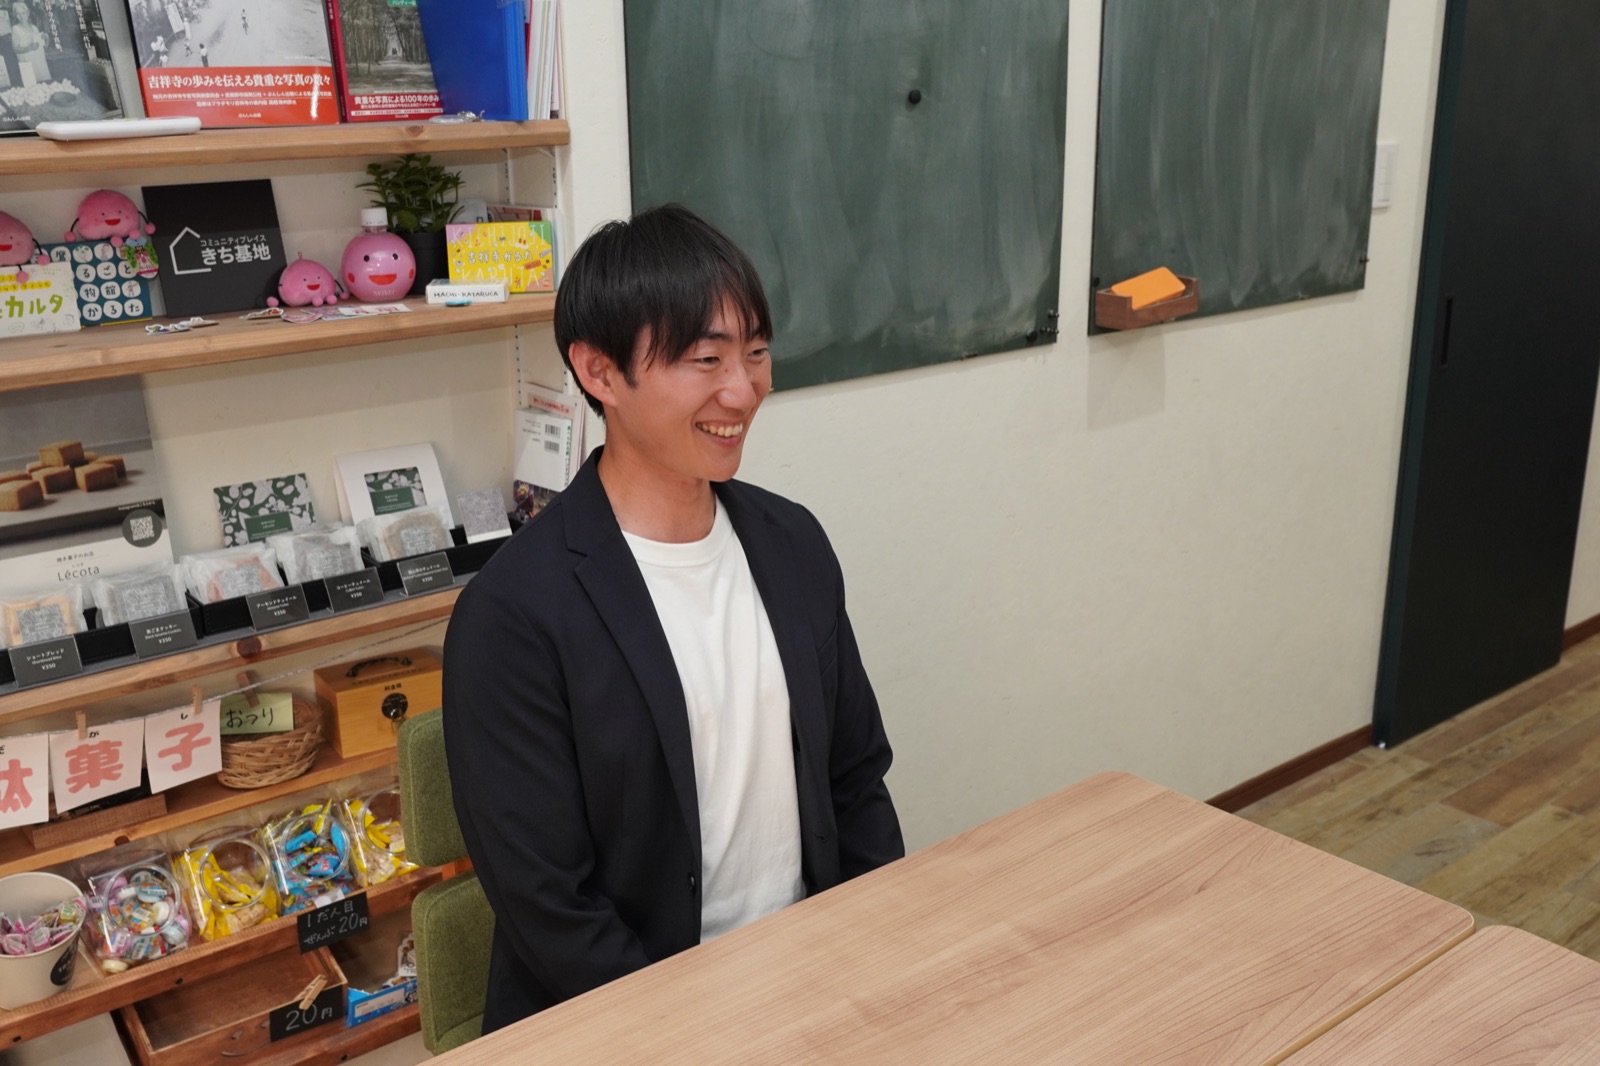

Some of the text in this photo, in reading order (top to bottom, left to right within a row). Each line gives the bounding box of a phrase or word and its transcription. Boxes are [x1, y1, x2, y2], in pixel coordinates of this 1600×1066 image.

[201, 242, 271, 266] きち基地
[0, 293, 63, 319] カルタ
[87, 303, 140, 317] かるた
[57, 566, 100, 582] Lécota
[158, 636, 172, 644] ¥350
[26, 648, 65, 661] ショートブレッド
[41, 662, 56, 670] ¥350
[225, 707, 274, 728] おつり
[338, 912, 368, 934] 20円
[285, 1003, 333, 1031] 20円
